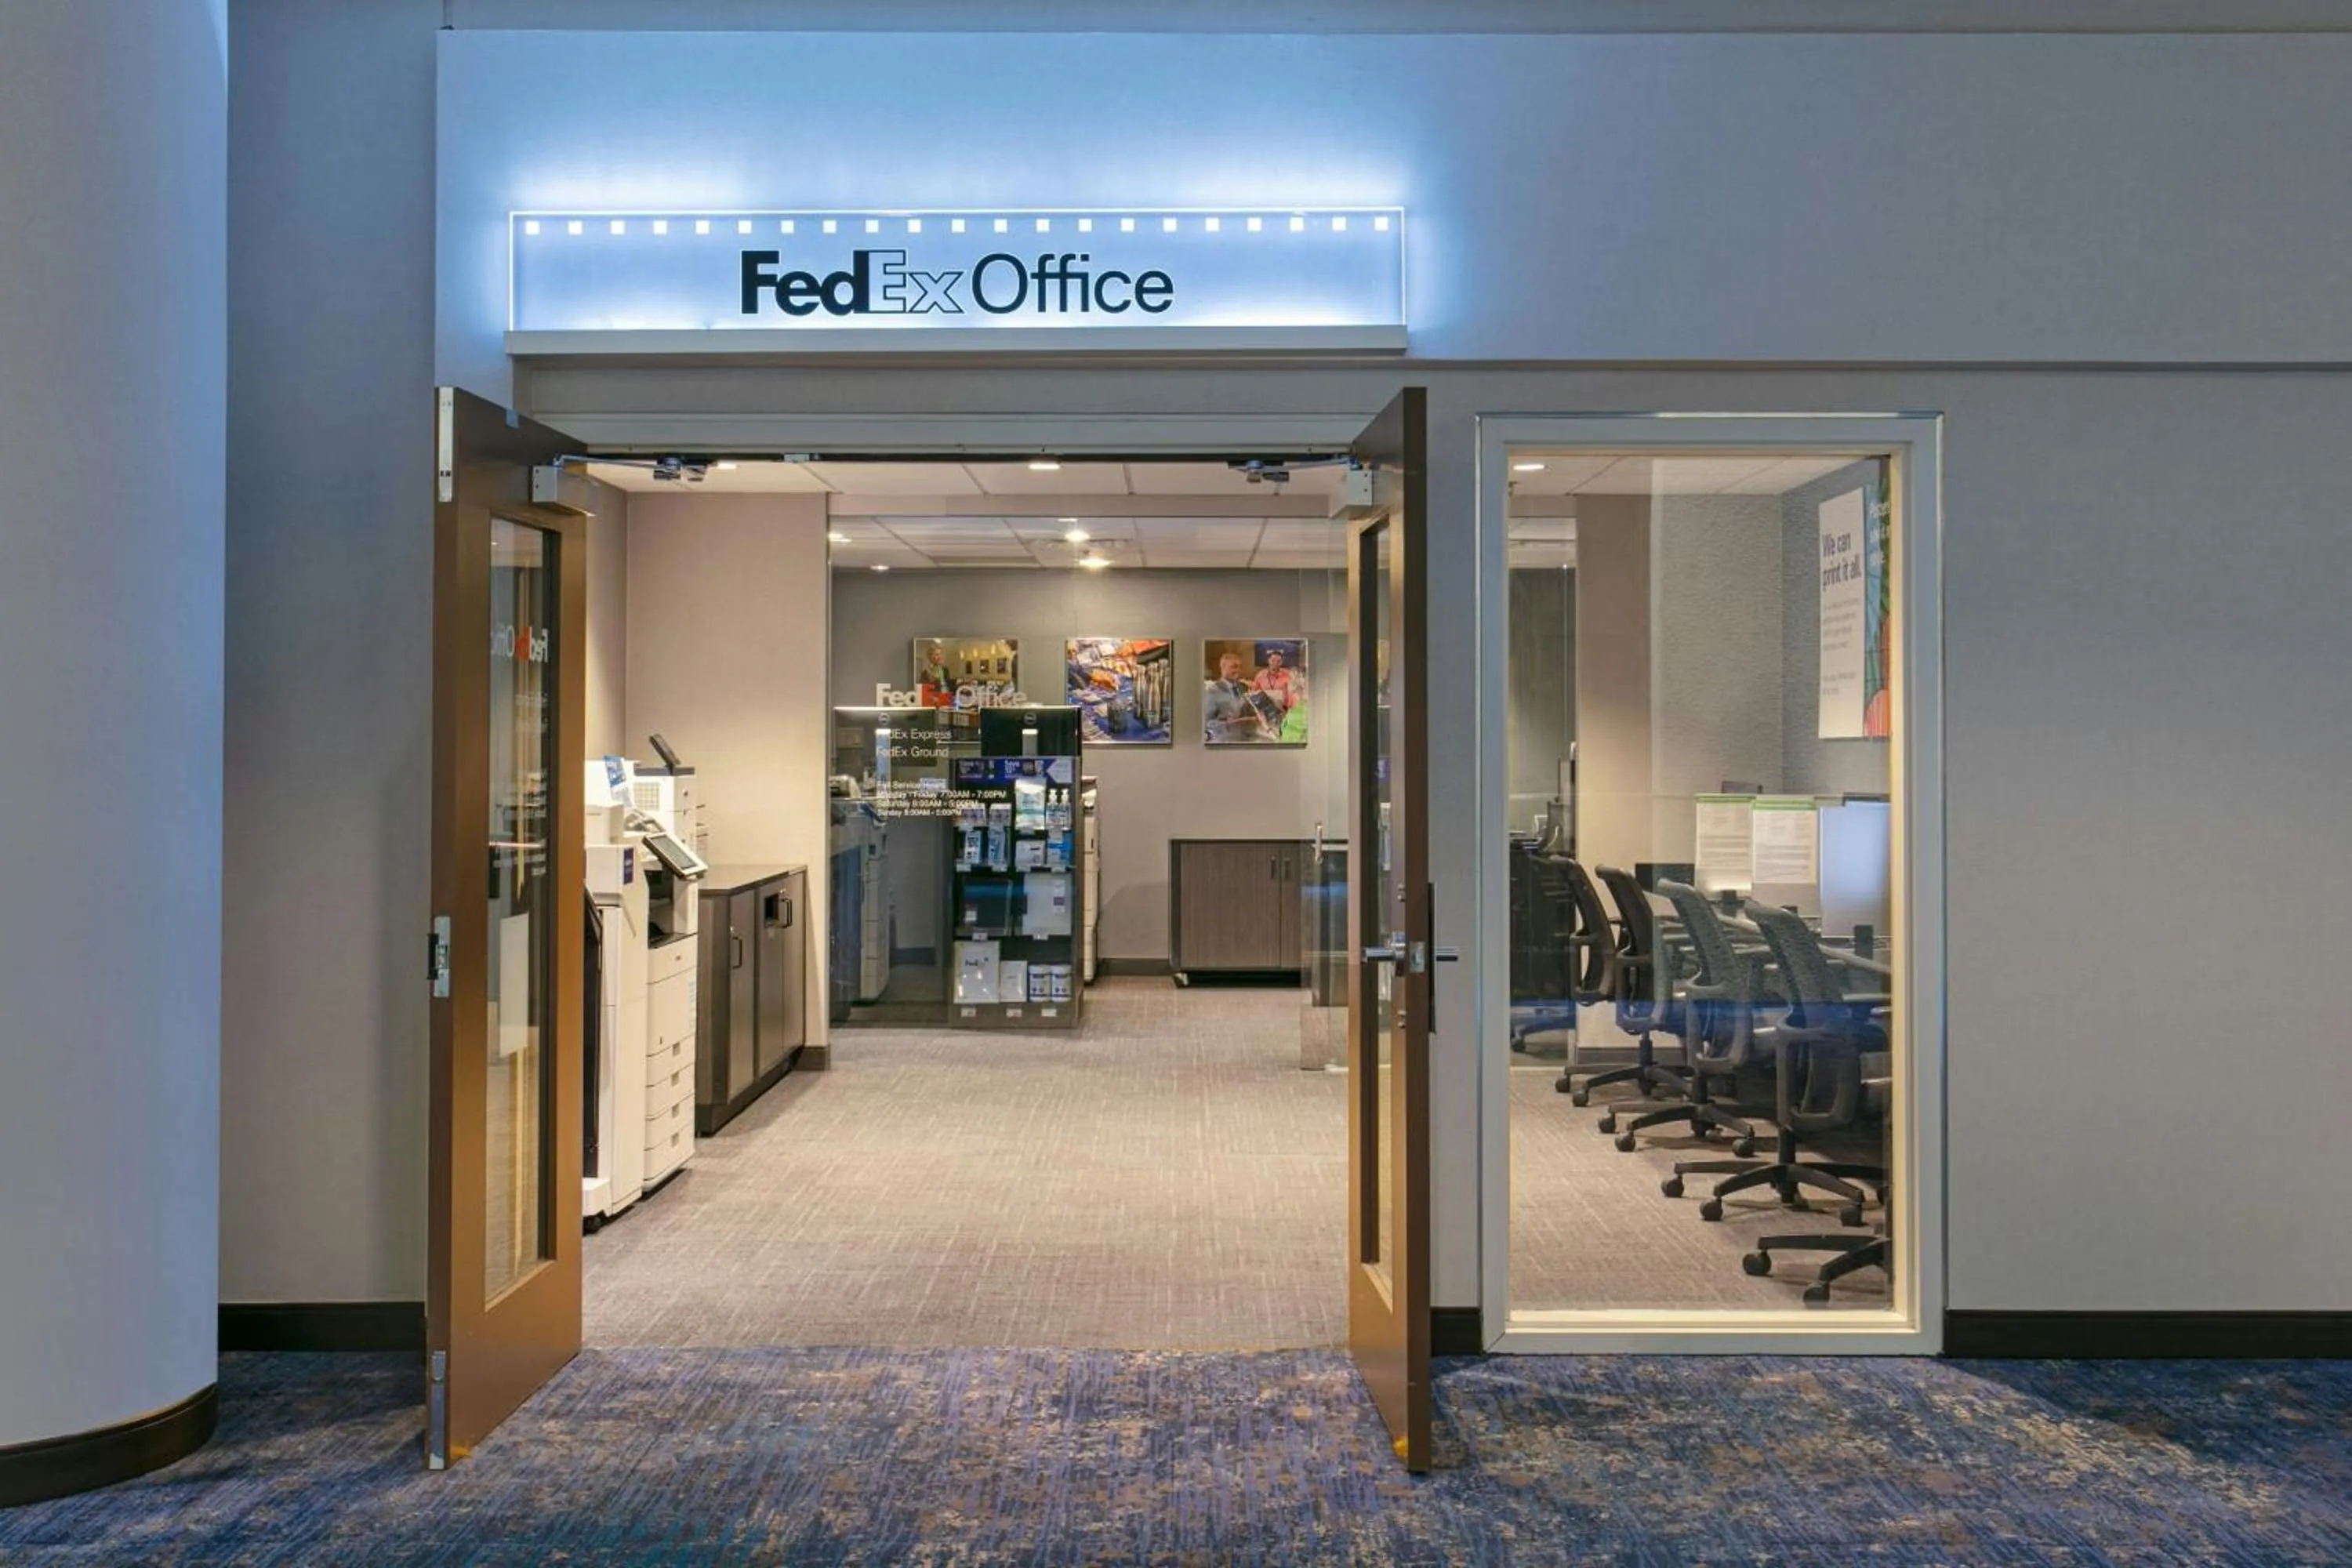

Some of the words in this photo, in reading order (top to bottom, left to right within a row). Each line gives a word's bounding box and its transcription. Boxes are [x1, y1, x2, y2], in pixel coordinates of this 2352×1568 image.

[740, 249, 965, 315] FedEx
[971, 252, 1174, 314] Office
[1821, 533, 1835, 558] We
[1837, 532, 1851, 553] can
[1822, 561, 1841, 593] print
[1842, 556, 1849, 582] it
[1849, 553, 1862, 579] all.
[876, 683, 954, 708] FedEx
[955, 684, 1027, 709] Office
[876, 729, 907, 739] dEx
[910, 728, 952, 742] Express
[910, 746, 949, 757] Ground
